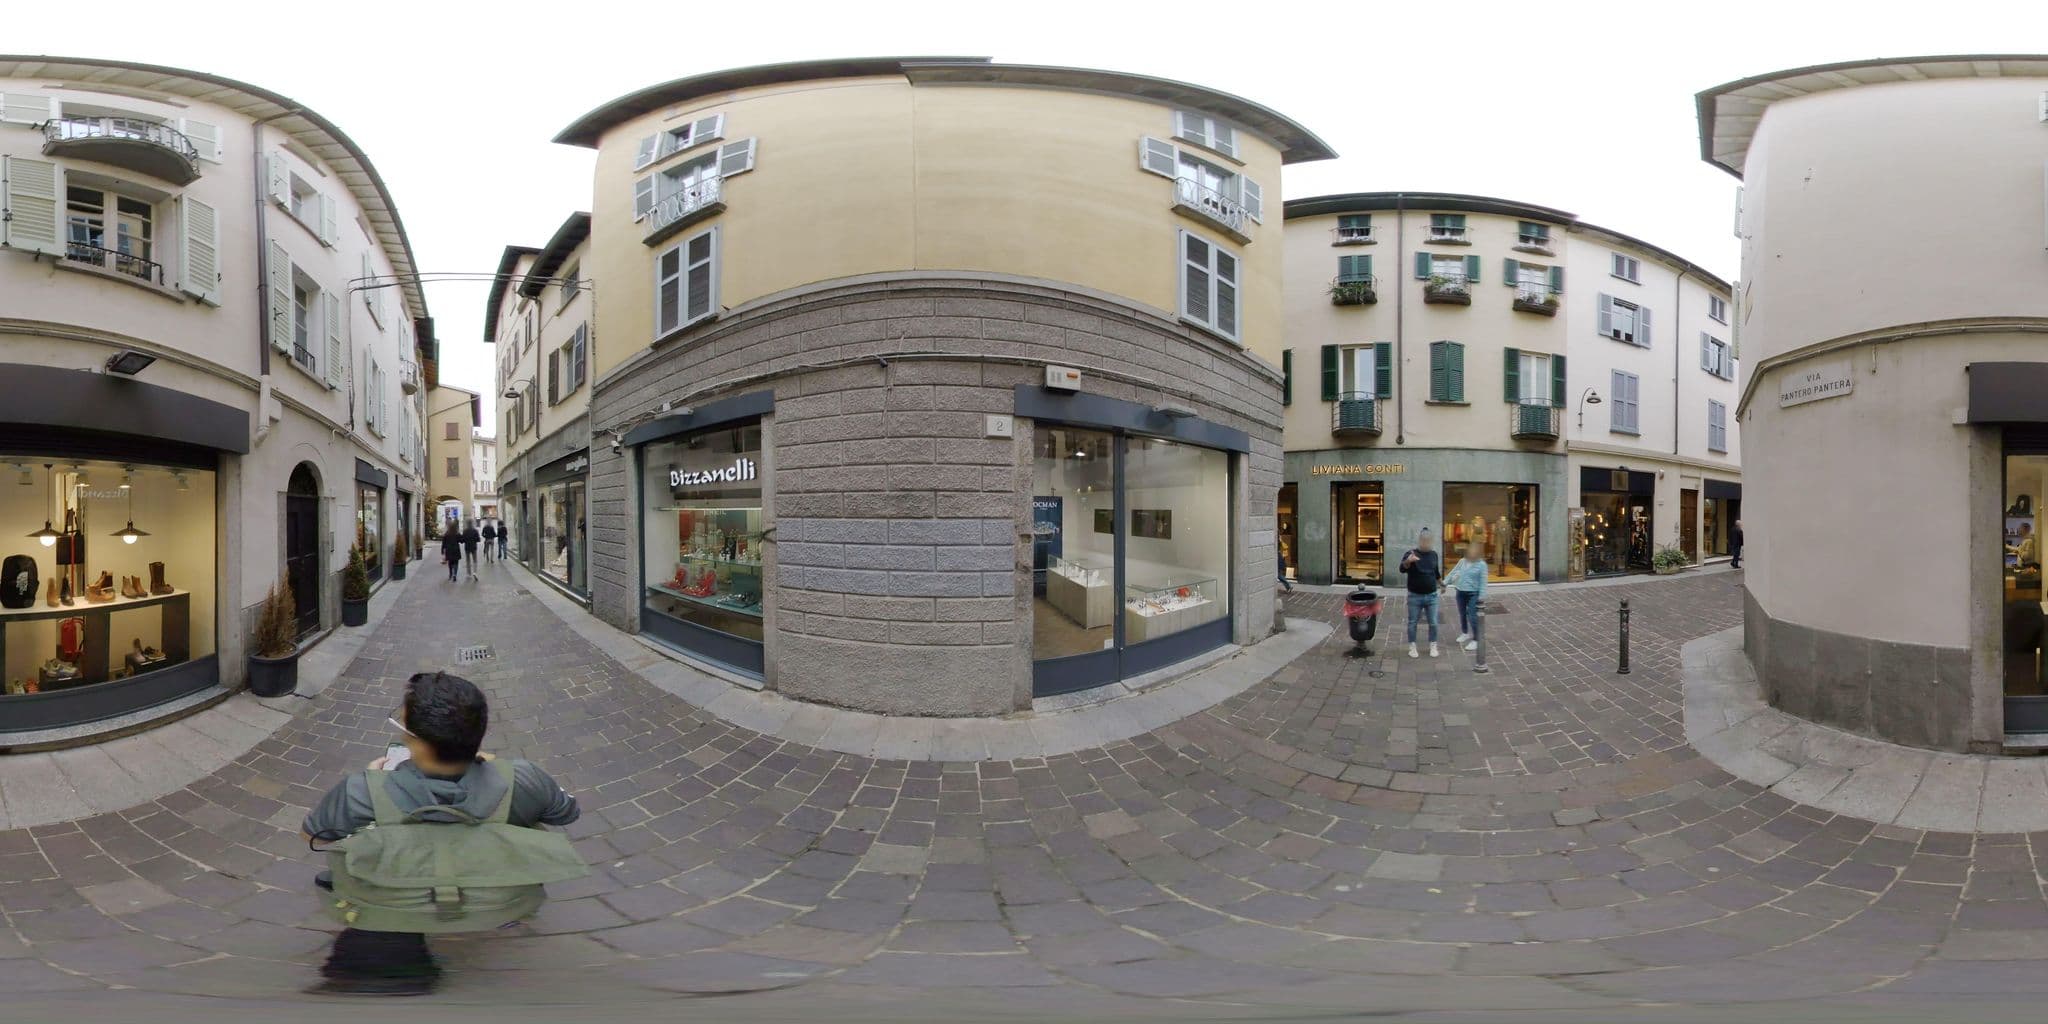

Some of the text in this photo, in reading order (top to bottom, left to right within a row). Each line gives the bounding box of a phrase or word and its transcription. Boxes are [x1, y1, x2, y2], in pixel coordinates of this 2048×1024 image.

[1806, 372, 1821, 382] VIA
[1781, 379, 1851, 402] PANTERO PANTERA
[996, 420, 1004, 432] 2
[670, 457, 755, 487] Bizzanelli
[1311, 463, 1405, 475] LIVIANA CONTI
